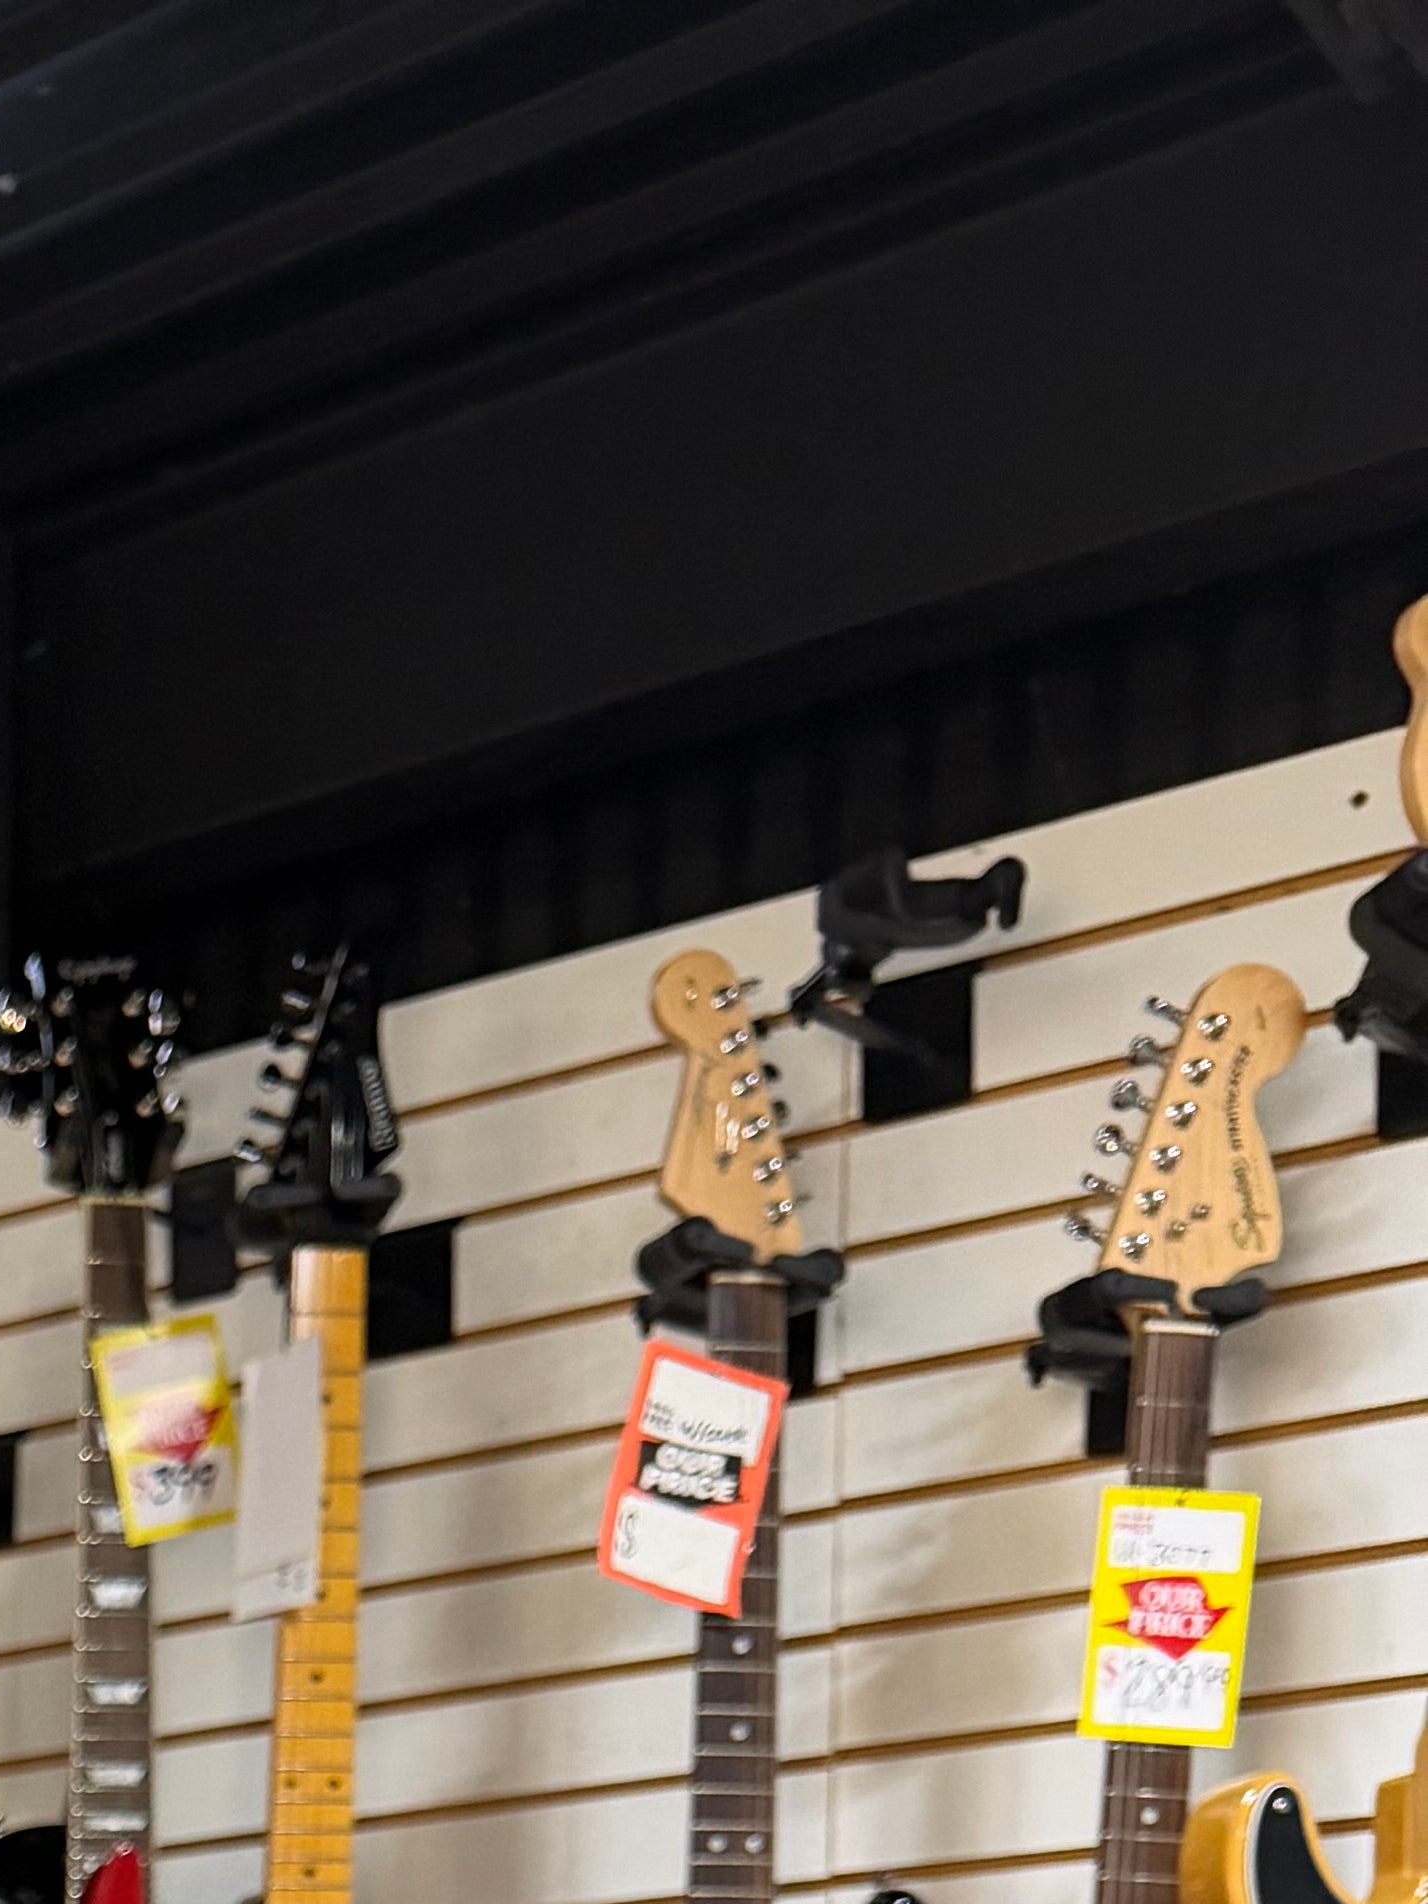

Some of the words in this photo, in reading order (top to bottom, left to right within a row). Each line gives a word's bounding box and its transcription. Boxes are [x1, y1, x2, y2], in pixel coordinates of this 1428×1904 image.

[654, 1441, 727, 1477] OUR
[638, 1462, 738, 1503] PRICE
[1138, 1581, 1206, 1613] OUR
[1126, 1609, 1214, 1640] PRICE
